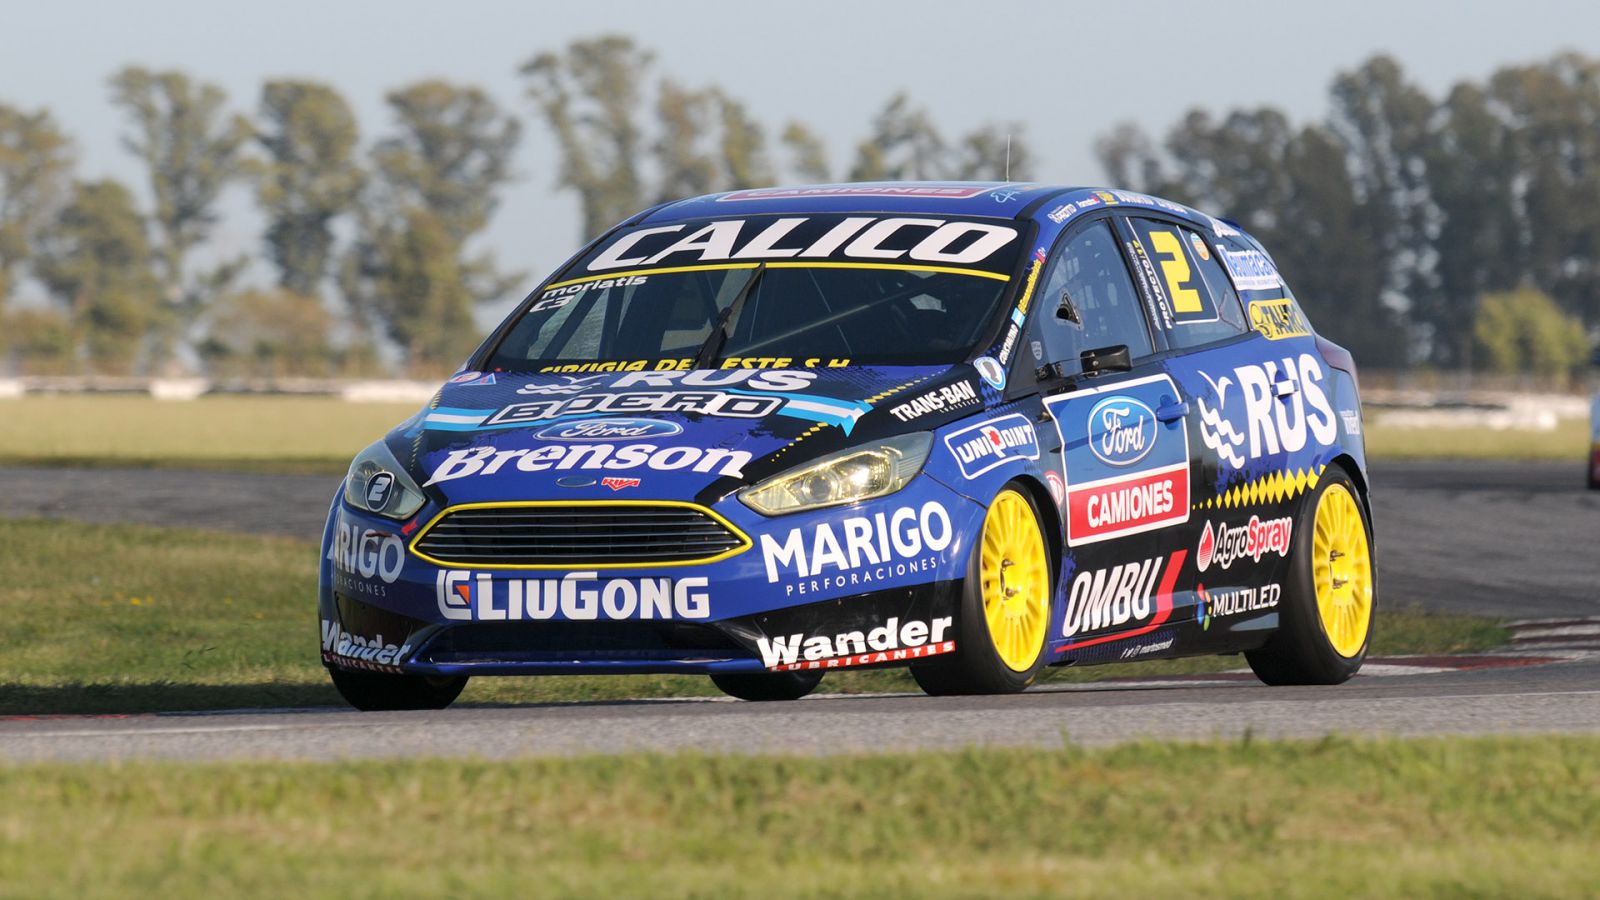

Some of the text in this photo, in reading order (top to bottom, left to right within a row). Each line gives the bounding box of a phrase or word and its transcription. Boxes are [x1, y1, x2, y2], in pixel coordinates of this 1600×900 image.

[587, 217, 1018, 271] CALICO
[542, 276, 648, 300] moriatis
[1149, 231, 1203, 313] 2
[609, 368, 818, 391] RUS
[890, 380, 977, 422] TRANS-BAN
[492, 391, 785, 426] BOERO
[1233, 353, 1337, 459] RUS
[1101, 407, 1147, 456] Ford
[422, 444, 752, 487] Brenson
[368, 476, 391, 502] 2
[1087, 479, 1174, 528] CAMIONES
[759, 501, 953, 584] MARIGO
[1213, 515, 1292, 569] AgroSpray
[786, 556, 937, 597] PERFORACIONES
[1062, 556, 1164, 638] OMBU
[1213, 584, 1281, 617] MULTILED
[757, 616, 953, 669] Wander
[771, 641, 954, 672] LUBRICANTES
